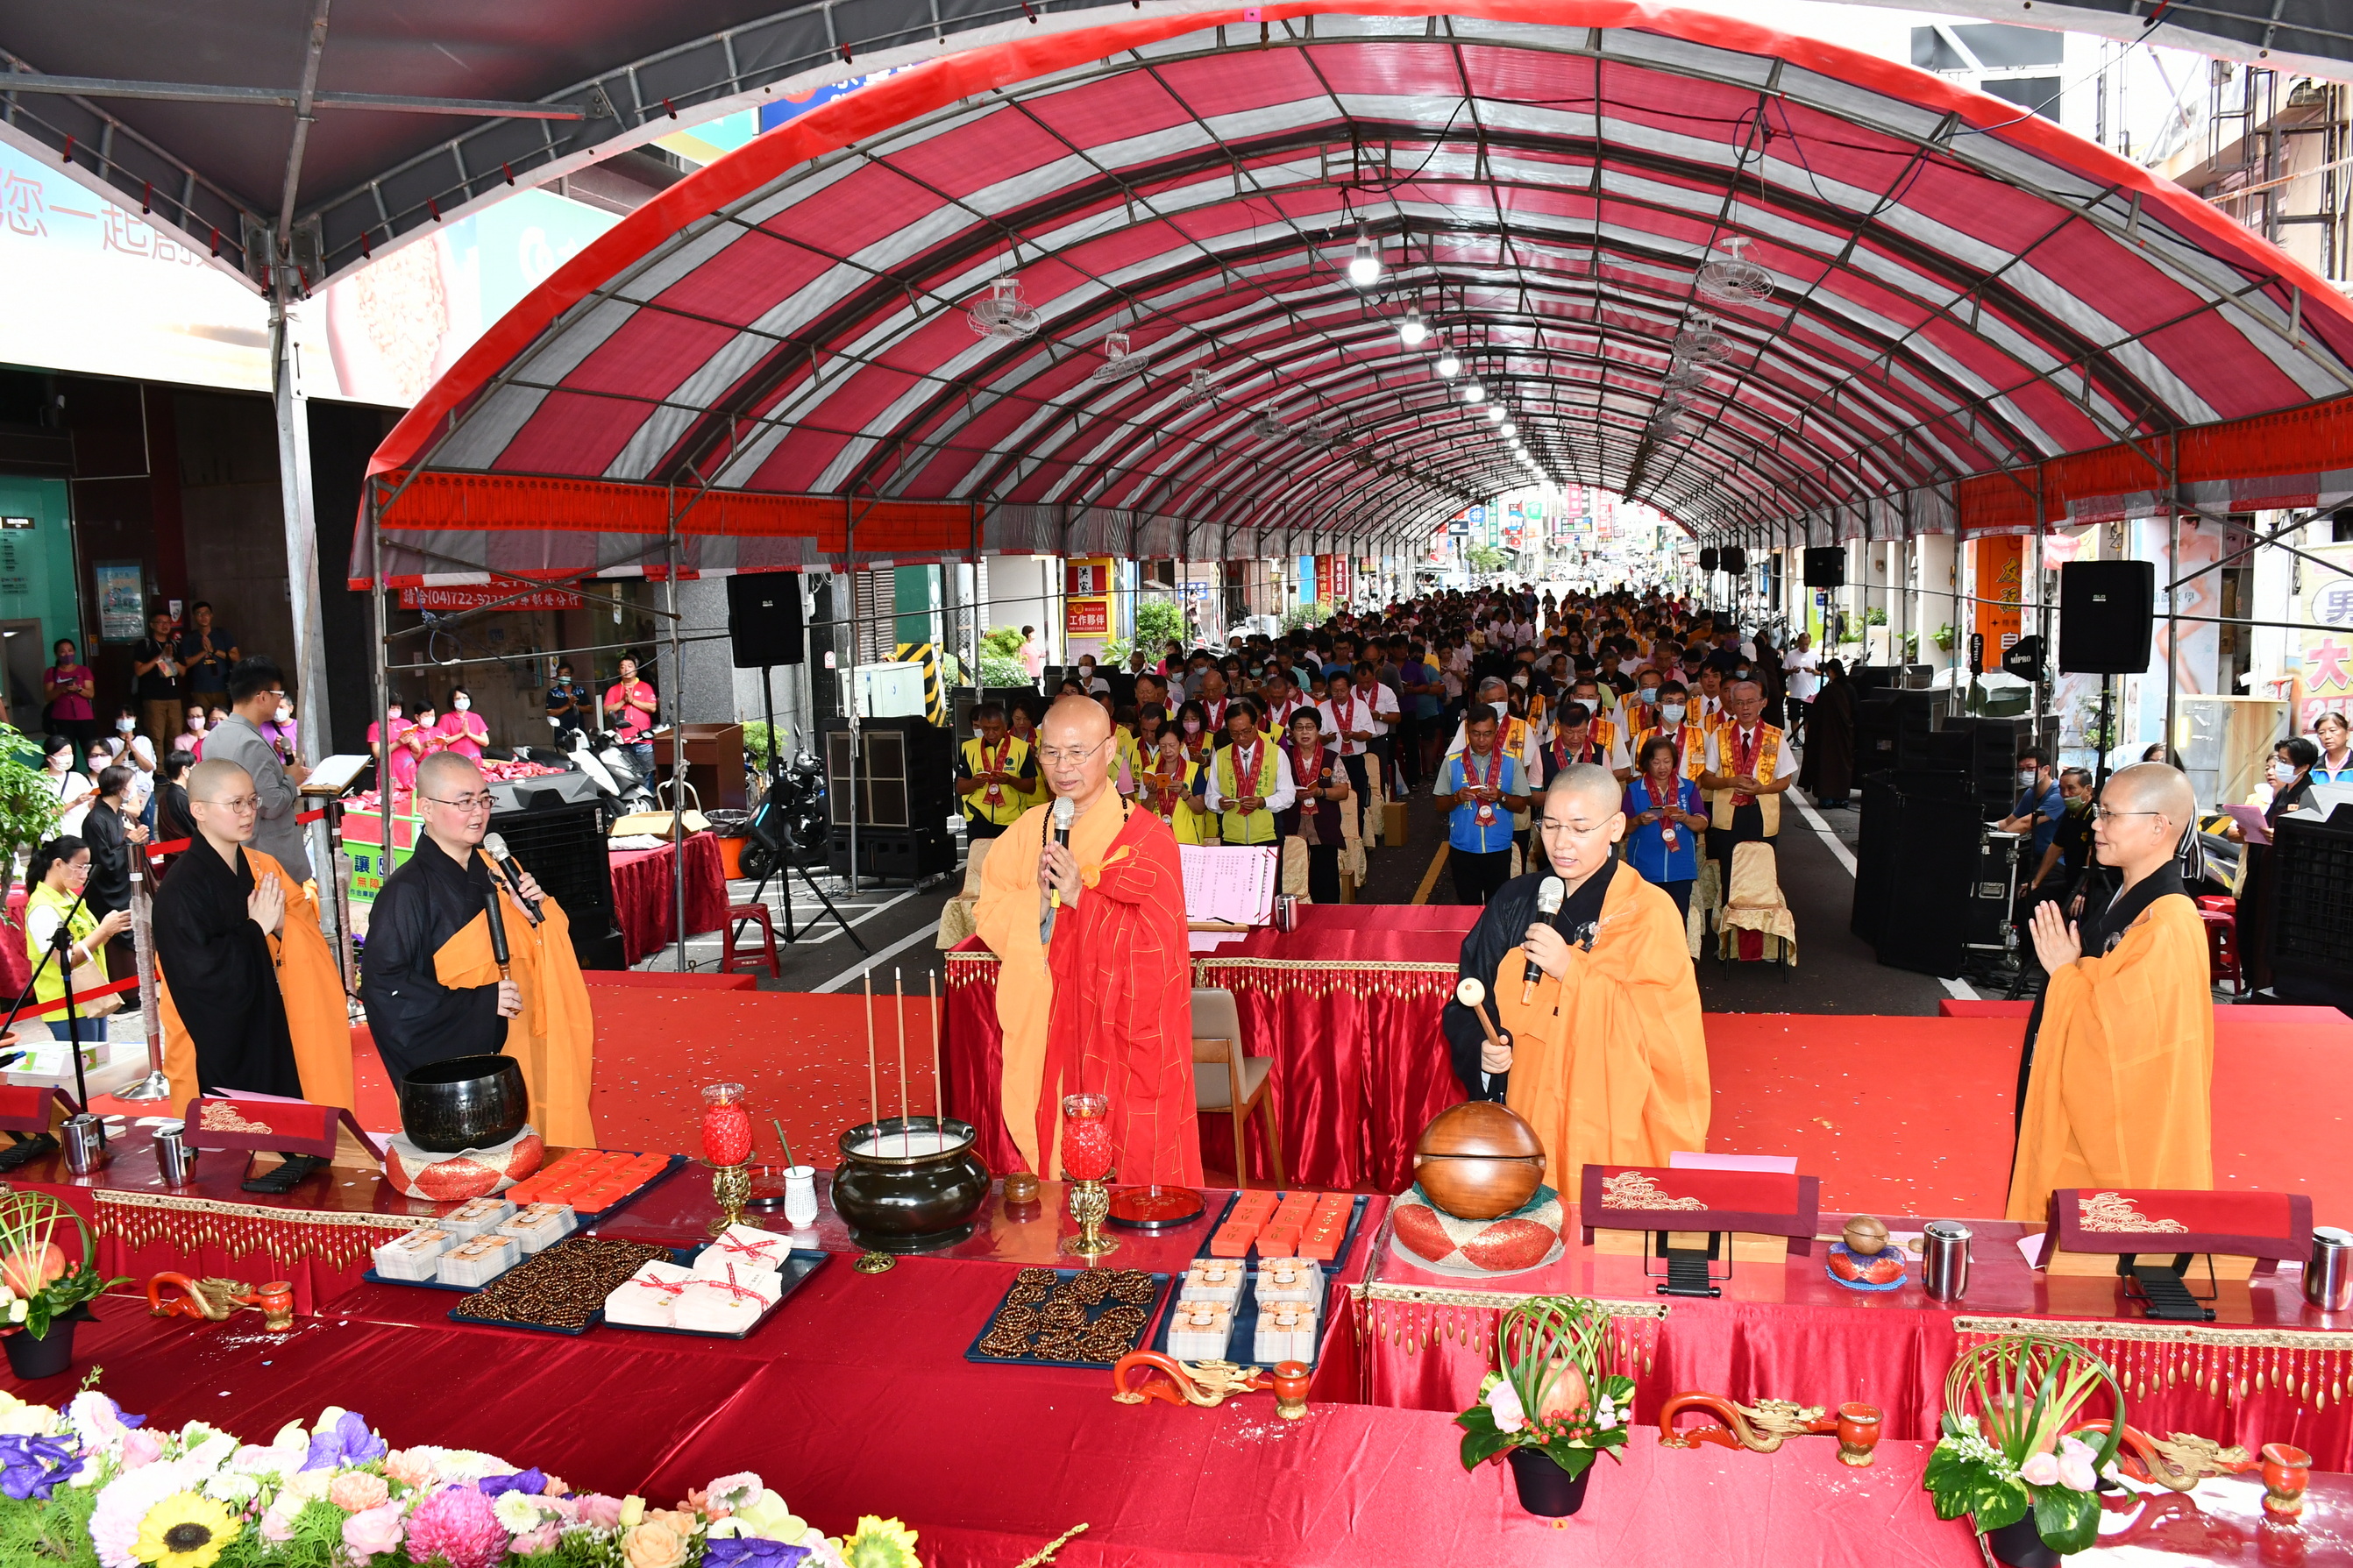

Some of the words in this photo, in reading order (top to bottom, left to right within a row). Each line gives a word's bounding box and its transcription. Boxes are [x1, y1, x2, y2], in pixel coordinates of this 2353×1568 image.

[1069, 614, 1105, 626] 工作夥伴
[2305, 637, 2352, 691] 大
